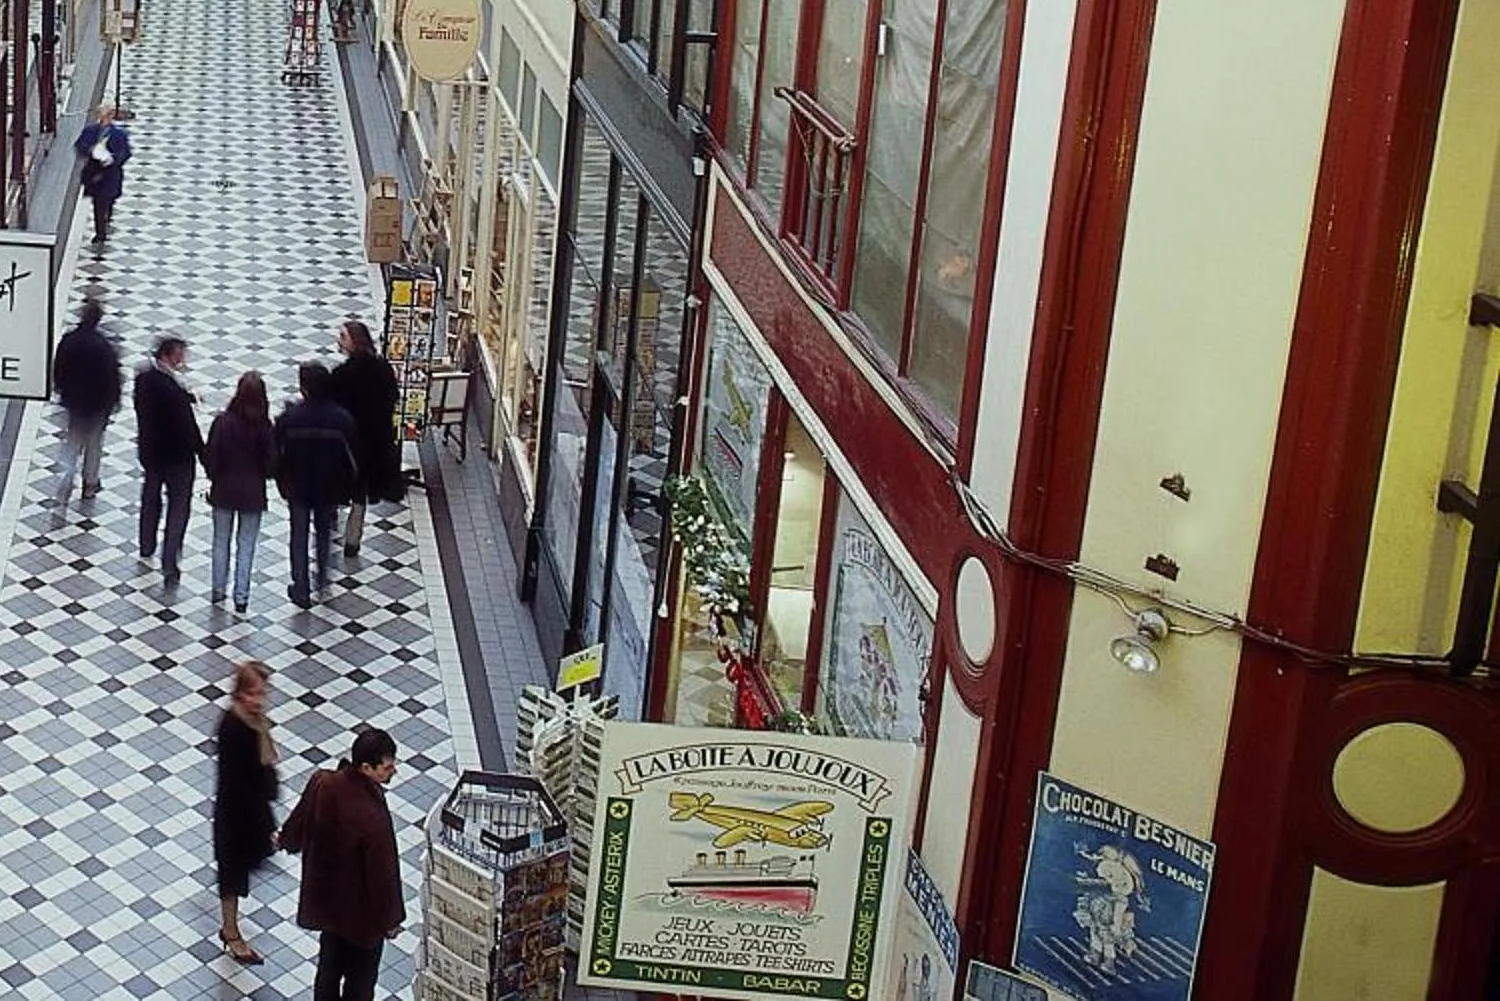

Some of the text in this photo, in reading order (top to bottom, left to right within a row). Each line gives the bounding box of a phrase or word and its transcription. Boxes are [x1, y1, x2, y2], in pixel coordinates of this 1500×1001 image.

[633, 758, 667, 779] LA
[670, 746, 734, 772] BOITE
[758, 749, 877, 796] JOUJOUX
[861, 843, 884, 903] TRIPLES
[1151, 857, 1205, 893] LE MANS
[596, 830, 625, 955] MICKEY ASTERIX
[655, 930, 807, 957] CARTES TAROTS
[662, 916, 802, 942] JEUX JOUETS
[619, 941, 677, 961] FARCES
[681, 948, 751, 967] ATTRAPES
[782, 956, 836, 974] SHIRTS
[635, 965, 821, 993] TINTIN BABAR
